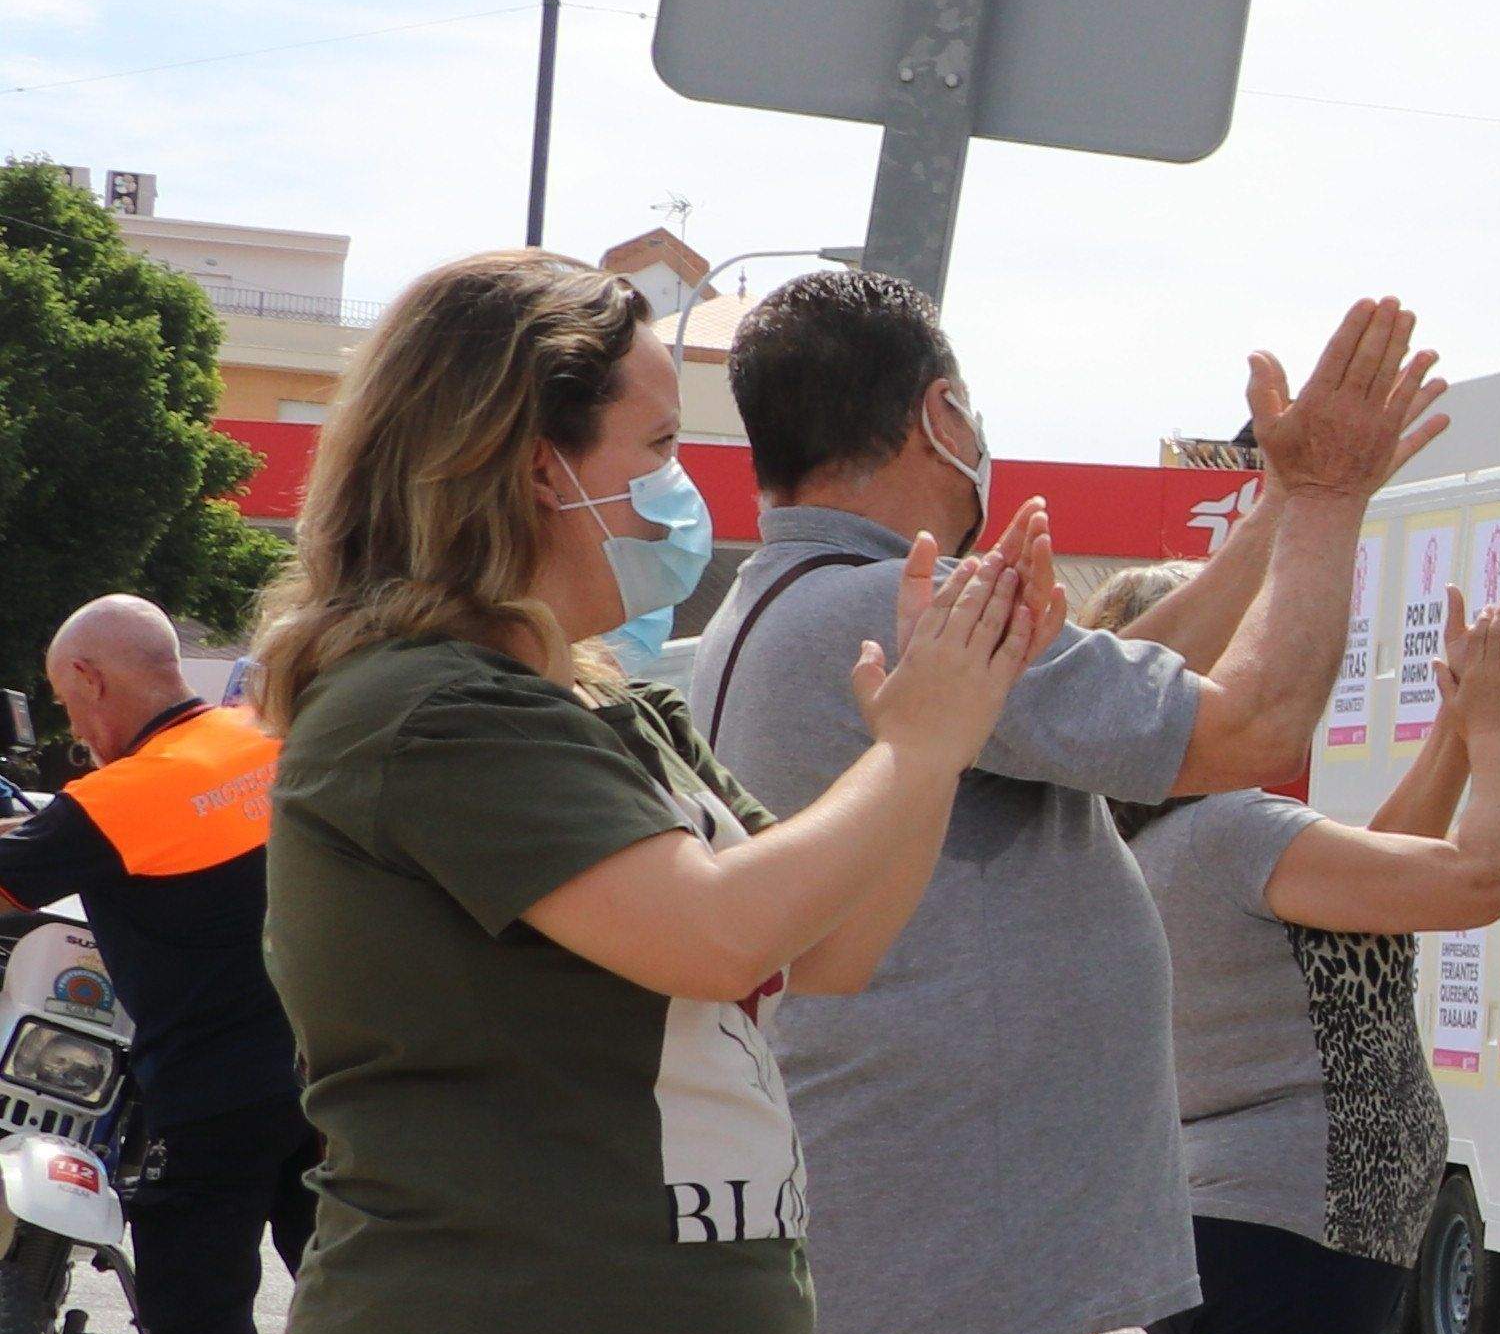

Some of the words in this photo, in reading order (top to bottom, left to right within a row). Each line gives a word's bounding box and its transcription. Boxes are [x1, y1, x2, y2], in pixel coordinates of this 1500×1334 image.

[1406, 603, 1425, 627] POR
[1428, 601, 1442, 624] UN
[1404, 630, 1439, 657] SECTOR
[1402, 662, 1428, 684] DIGNO
[1441, 961, 1479, 982] FERIANTES
[1440, 984, 1479, 1003] QUEREMOS
[1439, 1007, 1477, 1029] TRABAJAR
